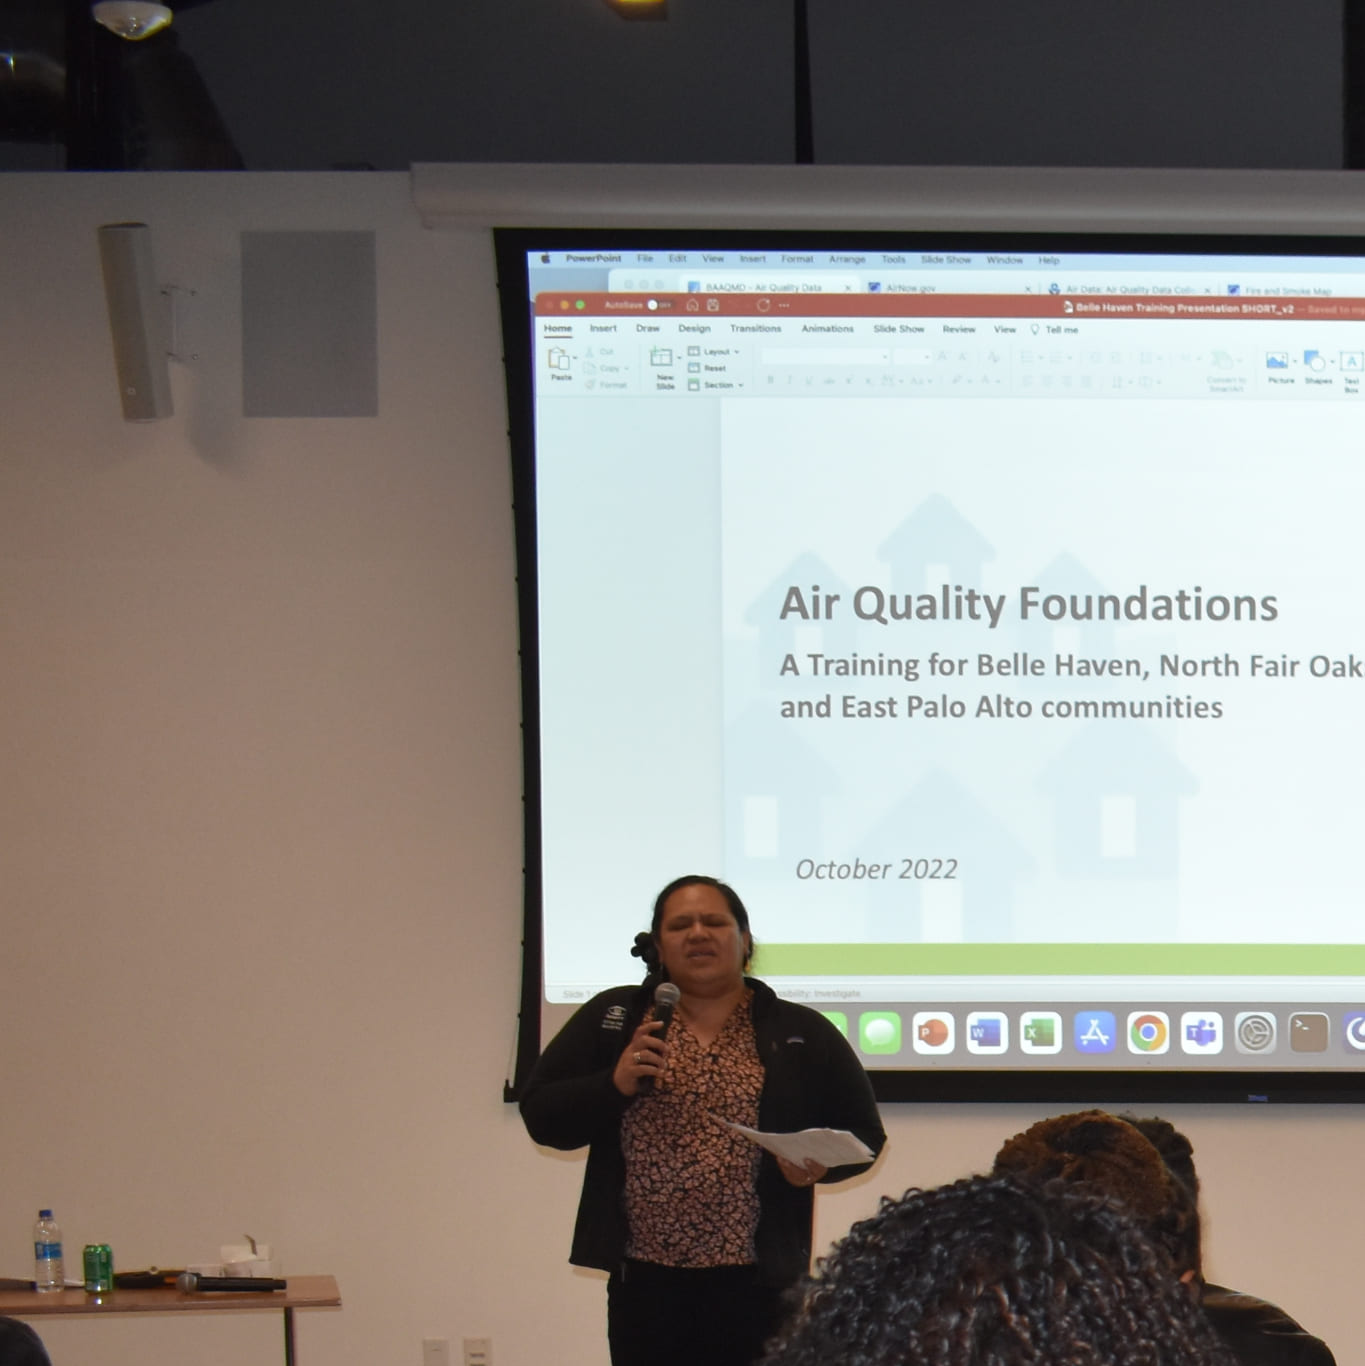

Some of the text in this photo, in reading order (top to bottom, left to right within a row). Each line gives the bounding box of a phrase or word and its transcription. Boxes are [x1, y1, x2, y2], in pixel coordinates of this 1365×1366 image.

[566, 254, 1061, 267] PowerPoint File Edit View Insert Format Arrange Tools Slide Show Window Help
[706, 283, 822, 294] BAAQMD Air Quality Data
[1076, 302, 1100, 313] Belle
[1103, 303, 1133, 313] Haven
[1136, 303, 1174, 315] Training
[1177, 303, 1240, 314] Presentation
[544, 324, 1078, 335] Home Insert Draw Design Transitions Animations Slide Show Review View Tell me
[704, 347, 730, 358] Layout
[704, 380, 734, 390] Section
[1268, 376, 1296, 386] Picture
[779, 585, 1279, 628] Air Quality Foundations
[780, 654, 800, 677] A
[808, 653, 920, 682] Training
[928, 653, 968, 677] for
[977, 653, 1046, 678] Belle
[1055, 654, 1150, 681] Haven,
[1159, 654, 1240, 678] North
[1250, 655, 1300, 678] Fair
[781, 694, 1224, 720] and East Palo Alto communities
[796, 857, 958, 881] October 2022
